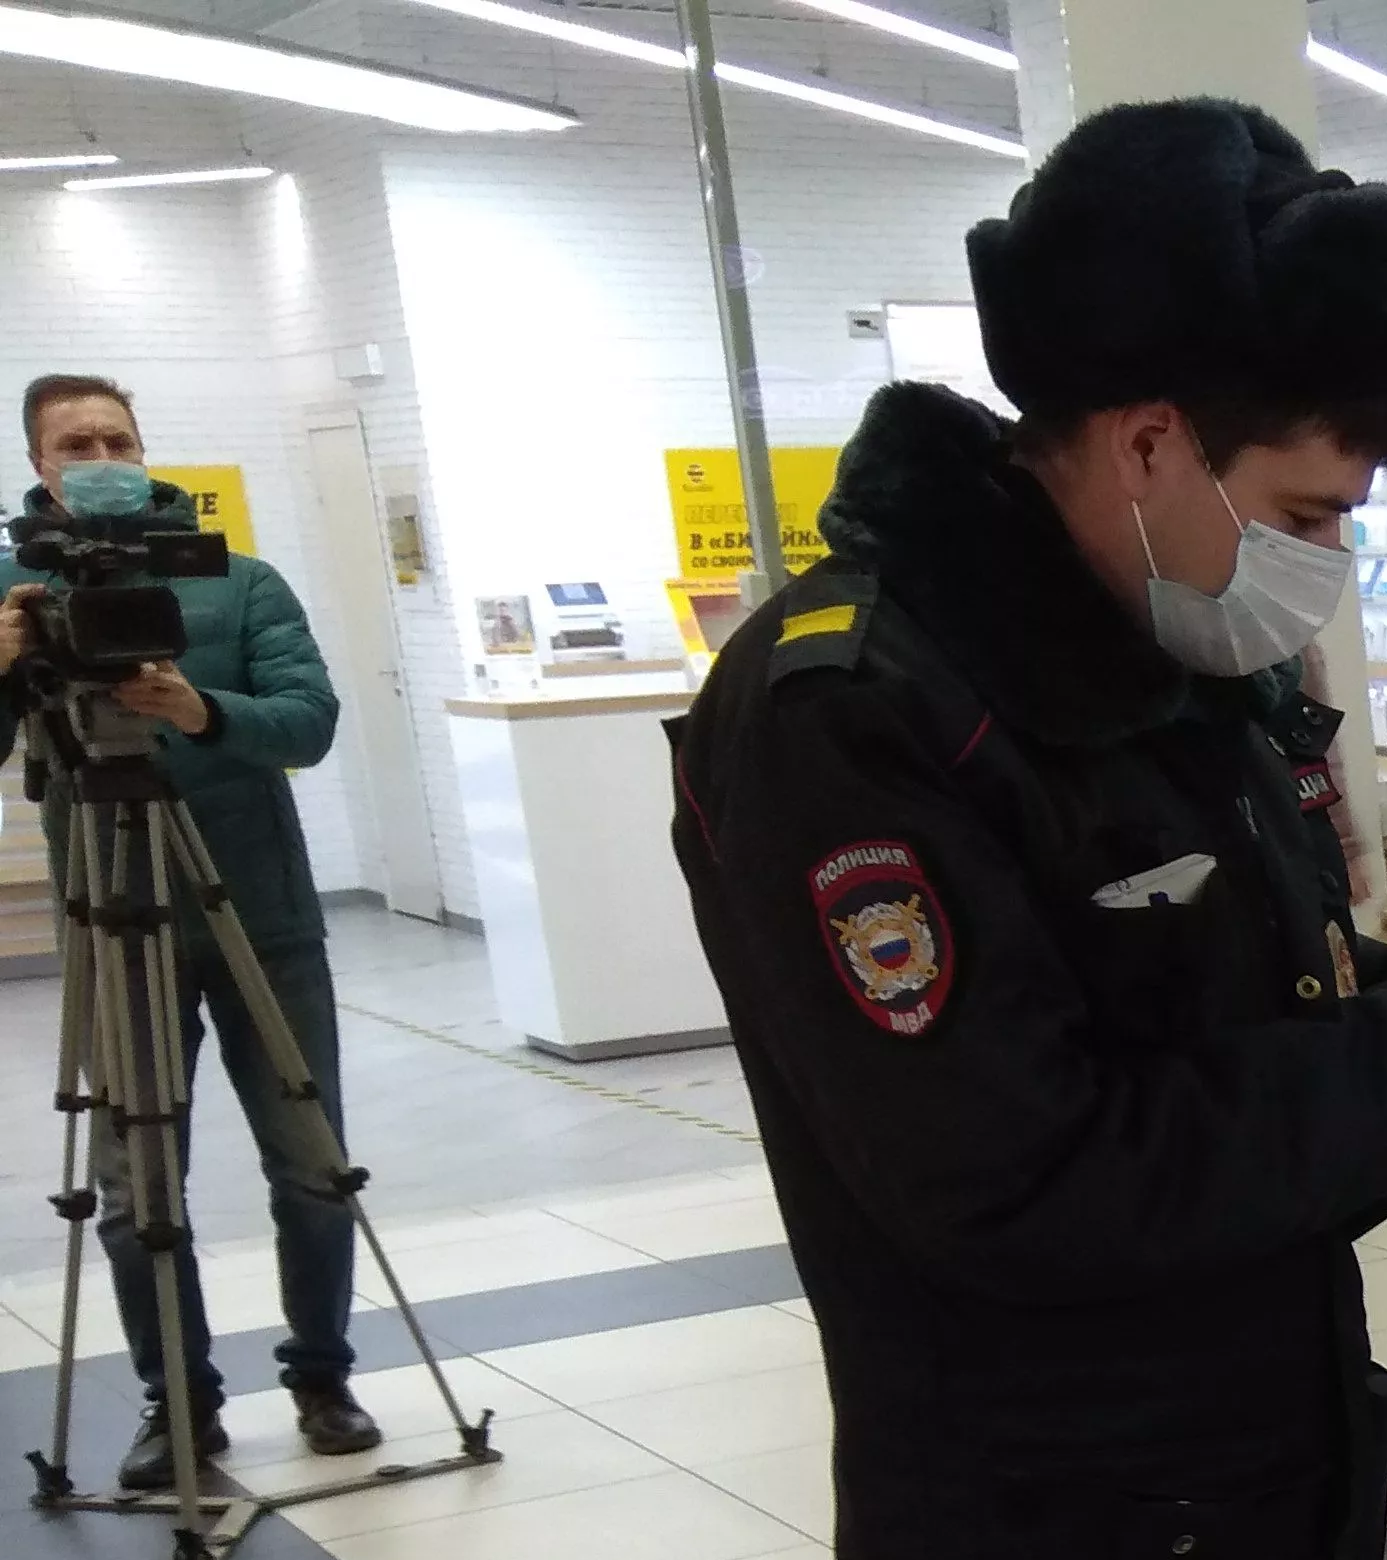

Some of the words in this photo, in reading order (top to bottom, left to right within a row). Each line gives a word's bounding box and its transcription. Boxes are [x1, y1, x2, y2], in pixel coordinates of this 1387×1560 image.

[690, 531, 703, 550] В
[709, 525, 823, 550] «БИЙН»
[815, 847, 911, 892] ПОЛИЦИЯ
[889, 1001, 934, 1034] МВД
